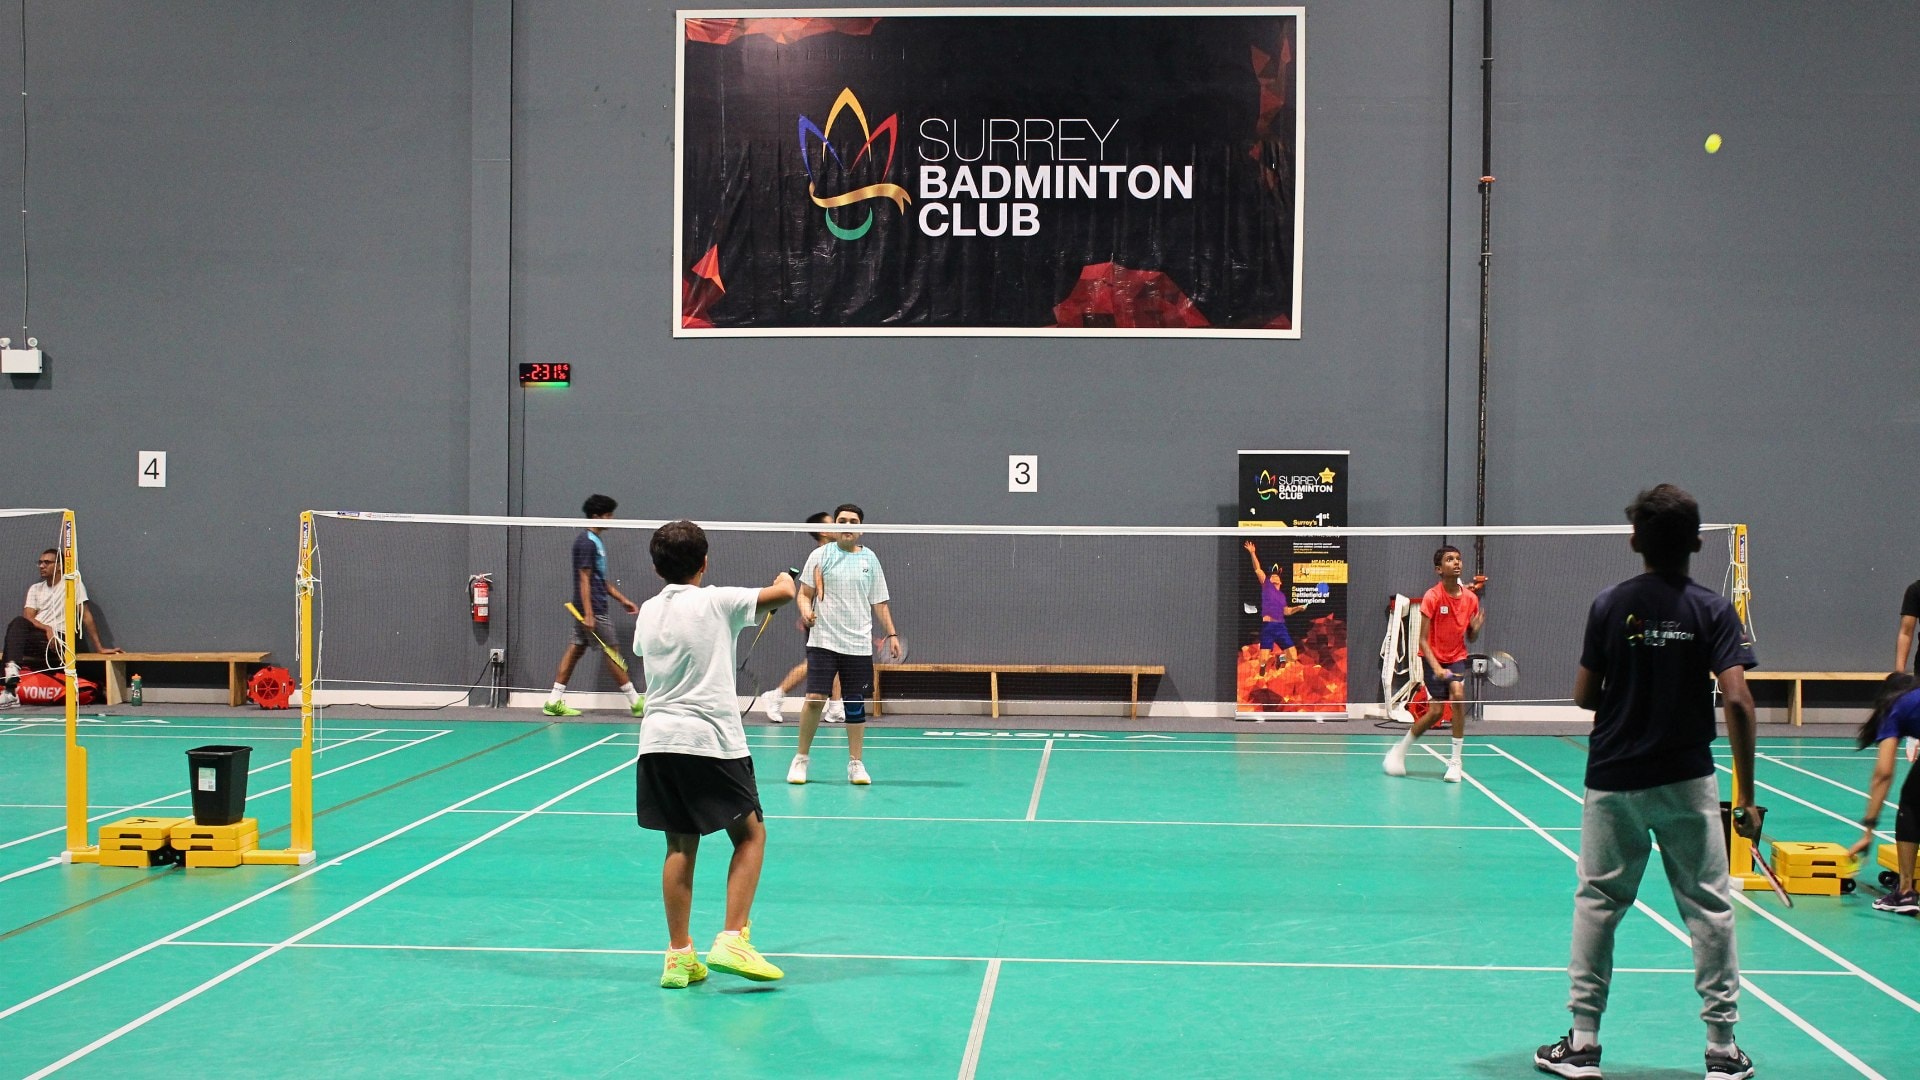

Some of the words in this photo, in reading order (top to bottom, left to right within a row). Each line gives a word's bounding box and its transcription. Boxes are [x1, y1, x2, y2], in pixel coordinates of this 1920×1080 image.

[918, 117, 1120, 162] SURREY
[919, 164, 1193, 200] BADMINTON
[918, 202, 1041, 237] CLUB
[144, 457, 160, 480] 4
[1015, 461, 1031, 485] 3
[1278, 475, 1320, 485] SURREY
[1278, 485, 1333, 493] BADMINTON
[1278, 492, 1304, 500] CLUB
[1292, 519, 1317, 527] Surrey's
[1315, 512, 1330, 527] 1st
